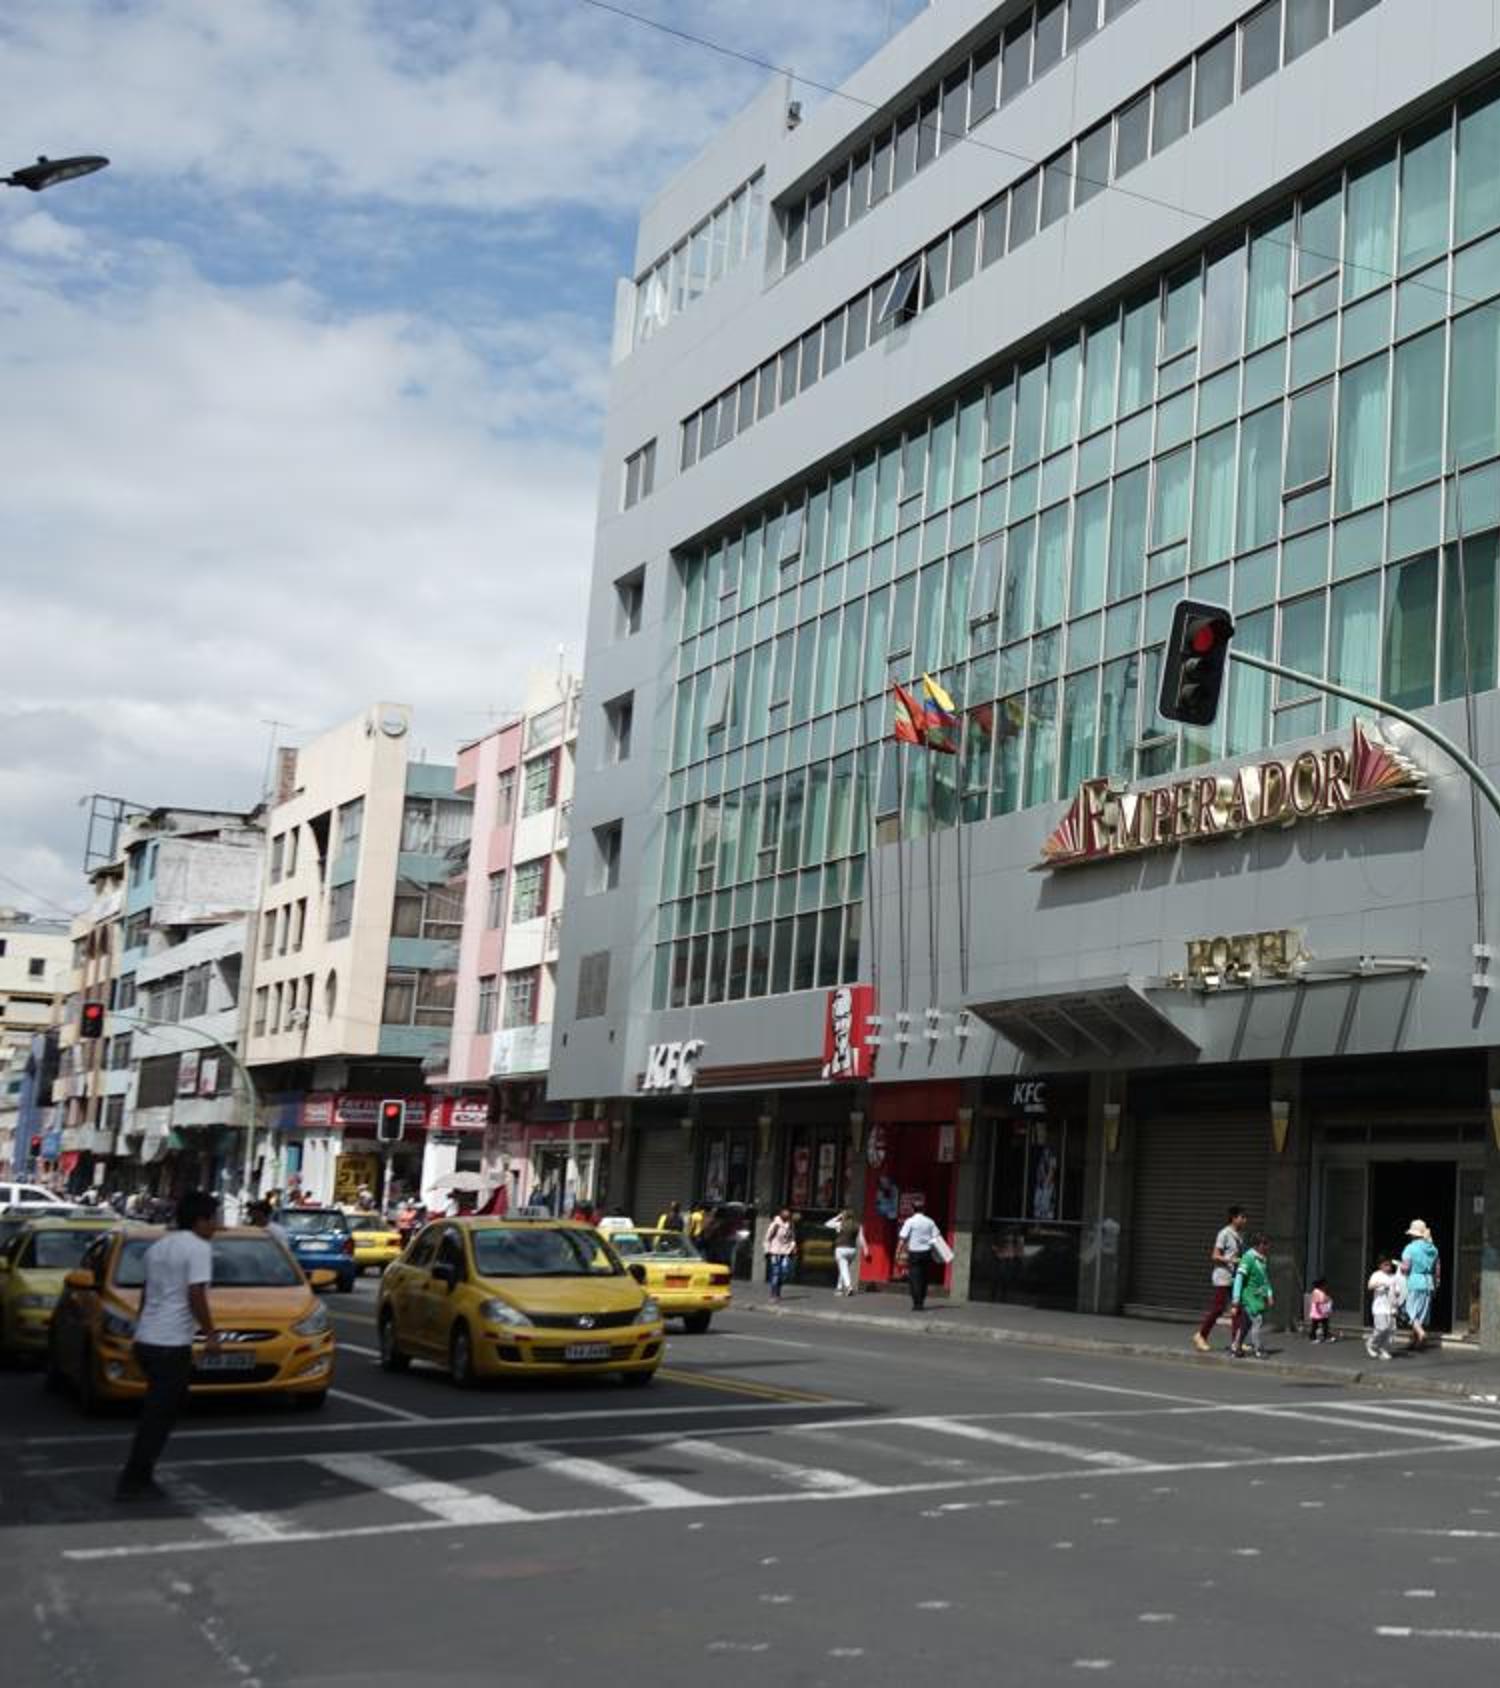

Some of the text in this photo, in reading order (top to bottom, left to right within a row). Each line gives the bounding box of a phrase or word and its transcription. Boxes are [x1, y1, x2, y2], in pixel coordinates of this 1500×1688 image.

[1082, 746, 1351, 856] EMPERADOR
[642, 1039, 705, 1090] KFC
[1013, 1081, 1046, 1104] KFC
